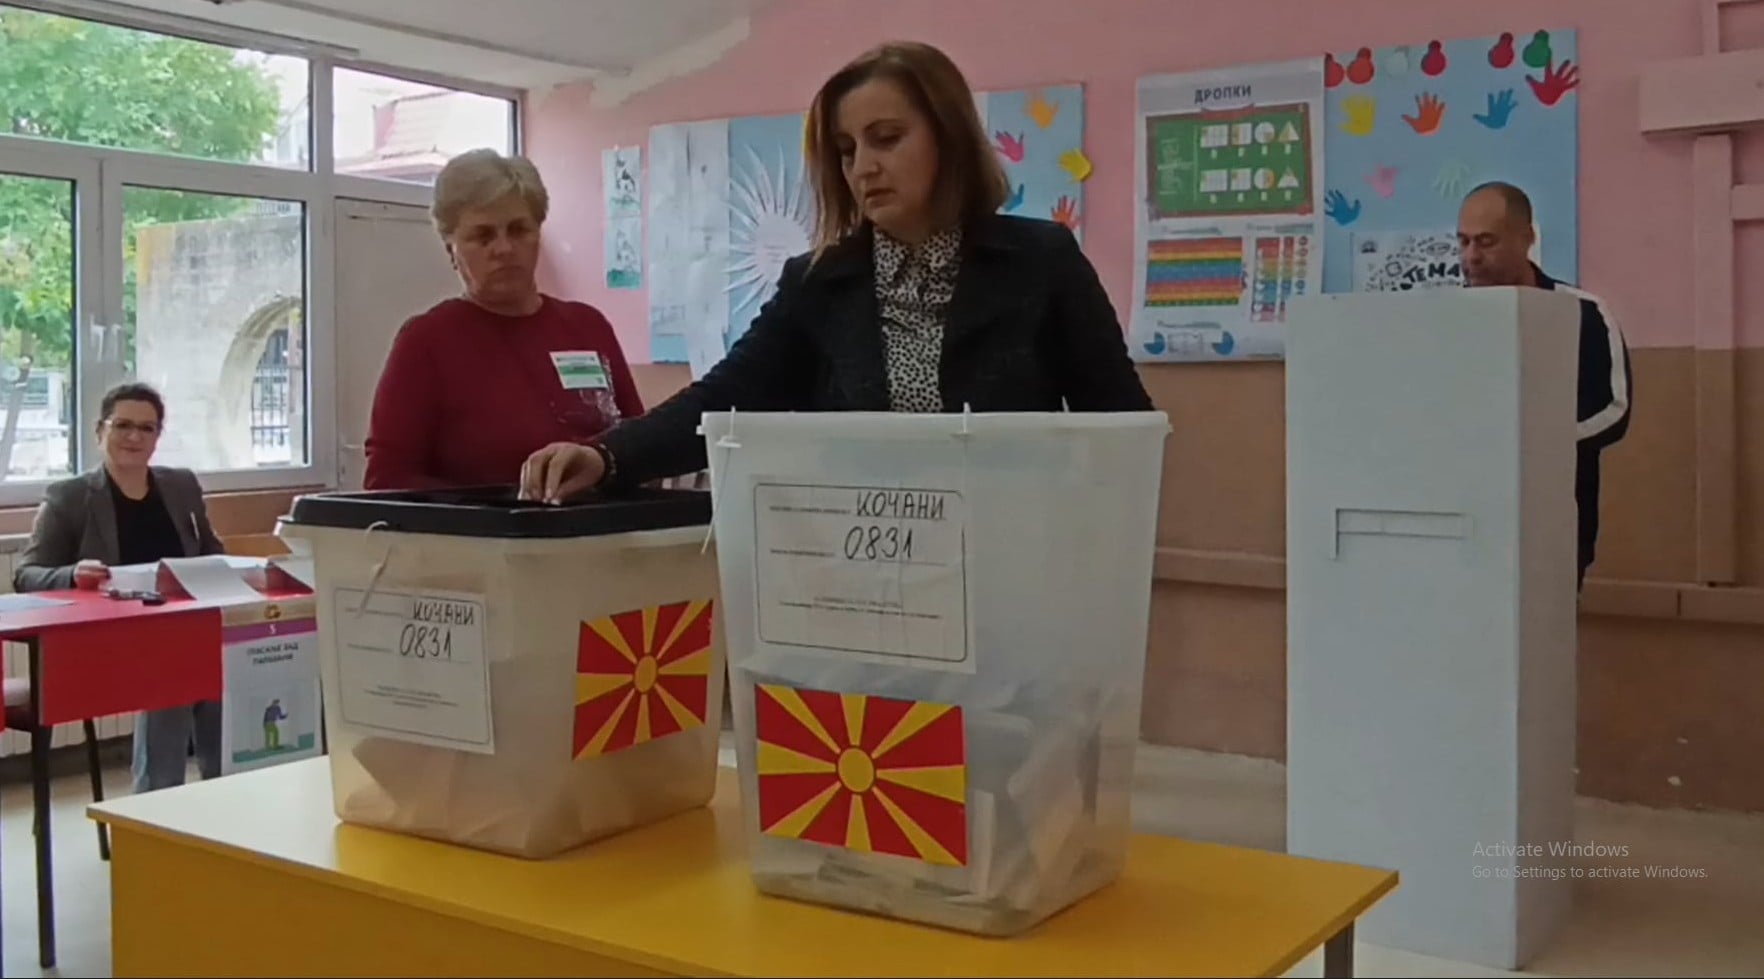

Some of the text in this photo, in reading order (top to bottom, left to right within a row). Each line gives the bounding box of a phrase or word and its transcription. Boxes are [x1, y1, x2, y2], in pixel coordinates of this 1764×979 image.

[1194, 85, 1251, 104] ДРОПКИ
[857, 491, 944, 519] КОЧАНИ
[844, 526, 912, 560] 0831
[413, 600, 474, 625] КОЧАНИ
[400, 623, 451, 660] 0831
